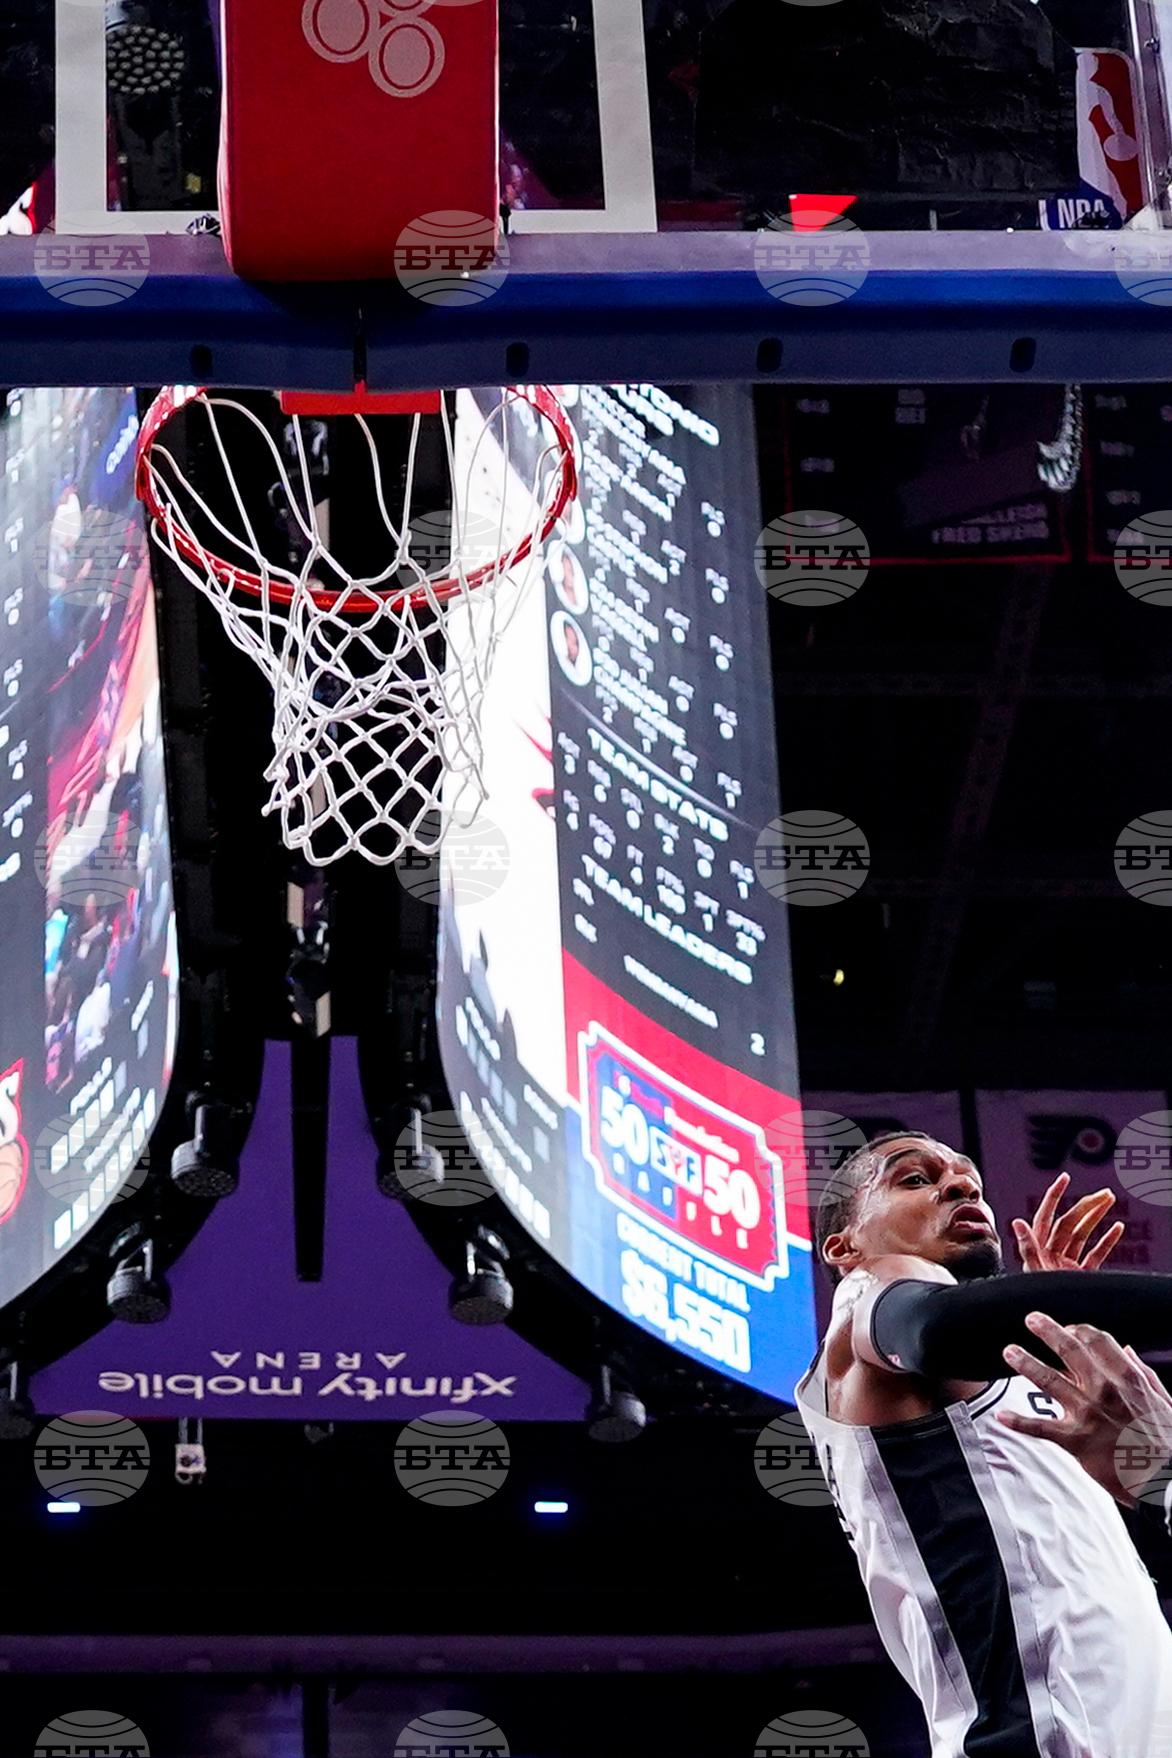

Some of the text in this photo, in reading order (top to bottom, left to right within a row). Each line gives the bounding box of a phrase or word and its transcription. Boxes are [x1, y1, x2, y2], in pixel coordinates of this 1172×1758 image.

[601, 1085, 761, 1230] 50 50
[210, 1350, 407, 1369] ARENA
[98, 1371, 517, 1403] xfinity mobile
